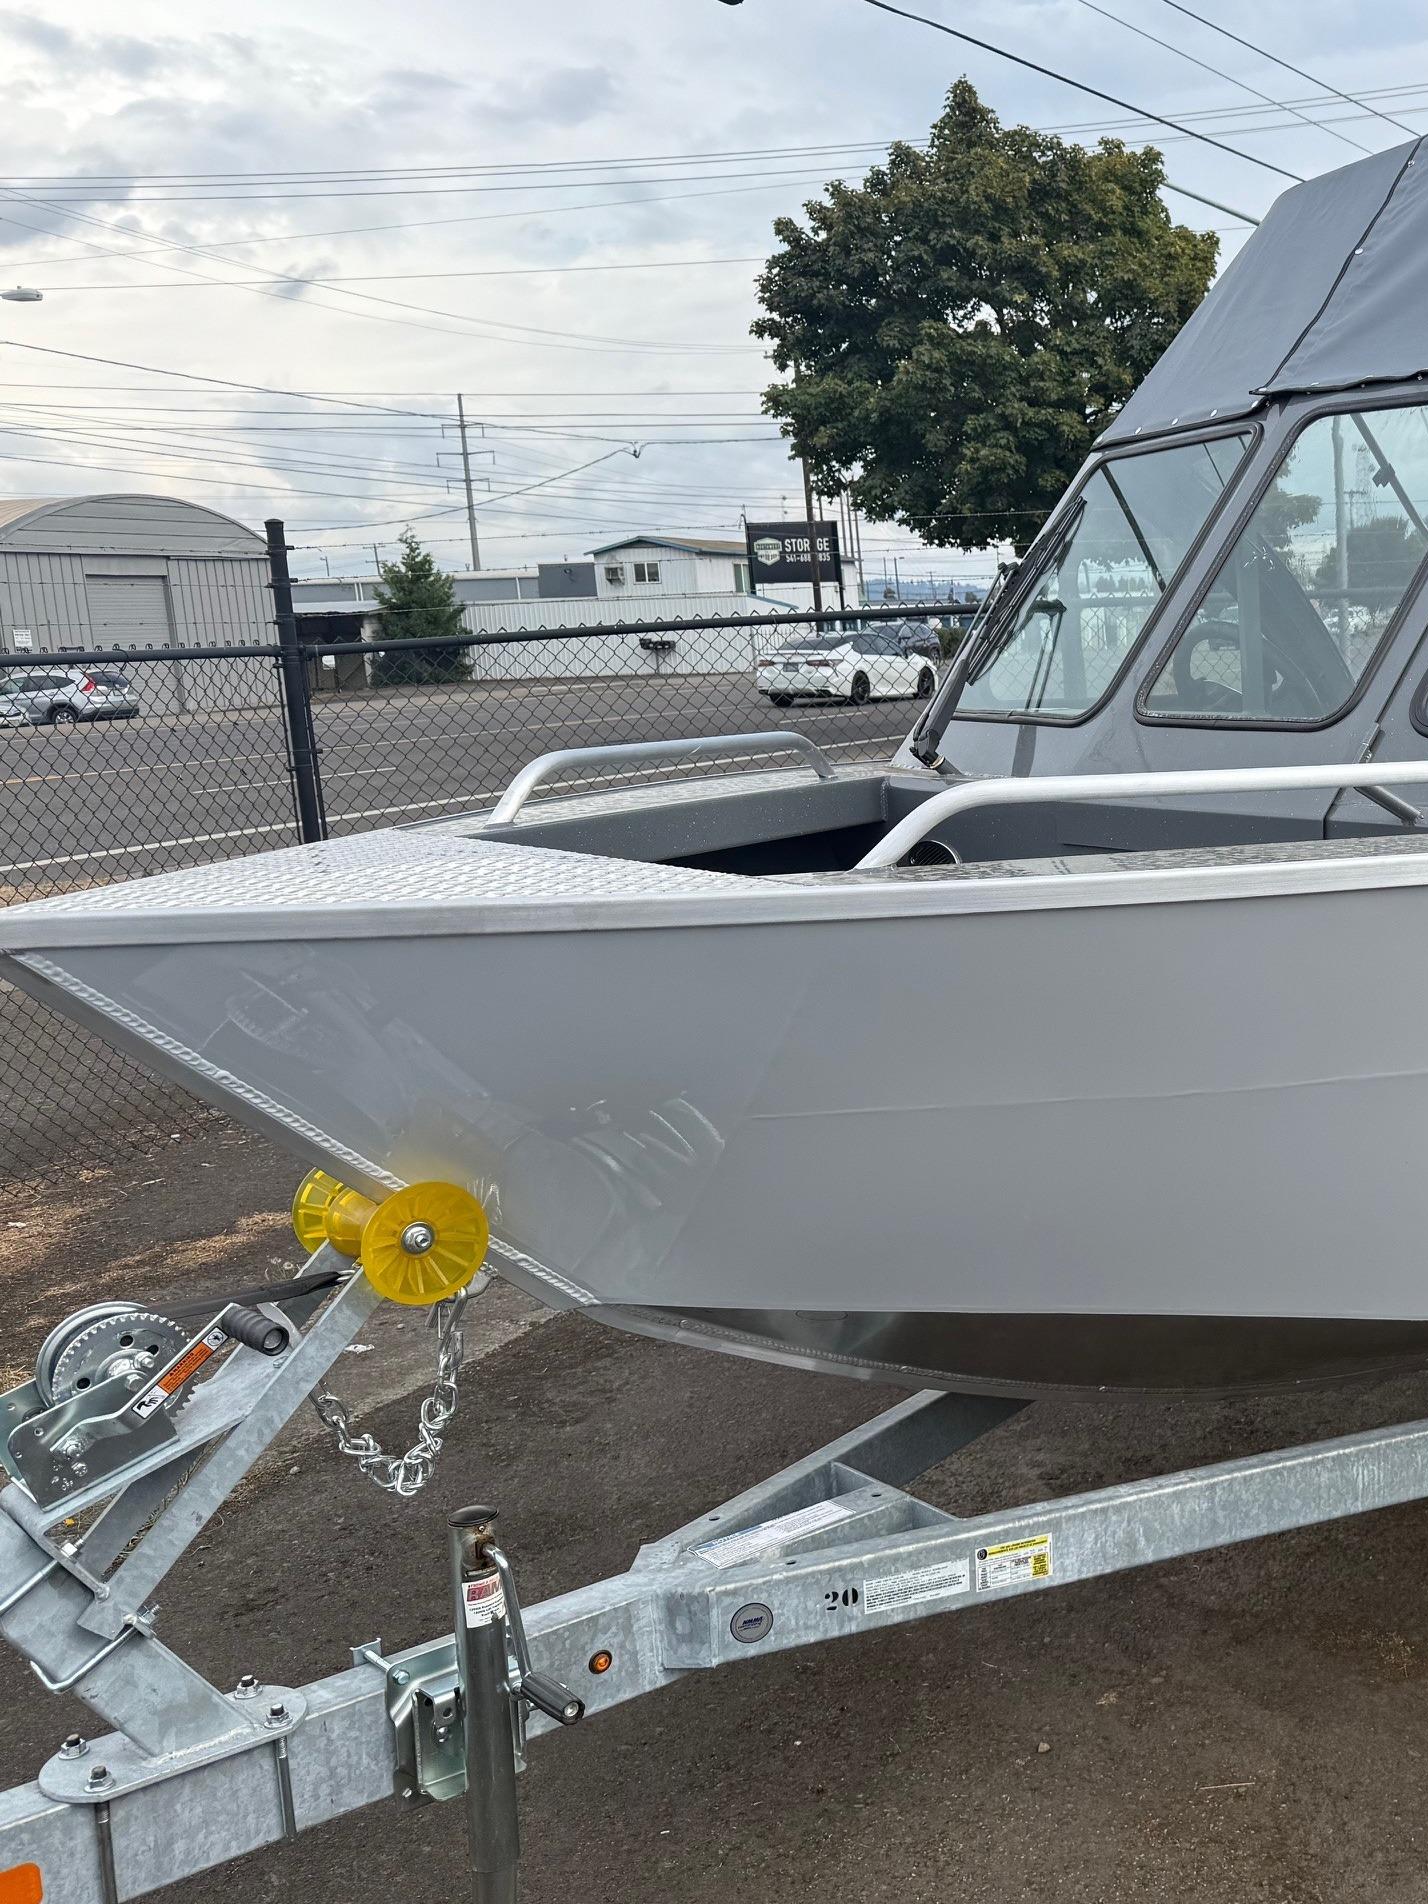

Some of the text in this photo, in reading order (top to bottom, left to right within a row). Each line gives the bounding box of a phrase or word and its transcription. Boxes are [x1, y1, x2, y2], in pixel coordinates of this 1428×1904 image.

[785, 538, 830, 552] STORGE
[786, 553, 831, 563] 541-688835
[824, 1587, 859, 1611] 20
